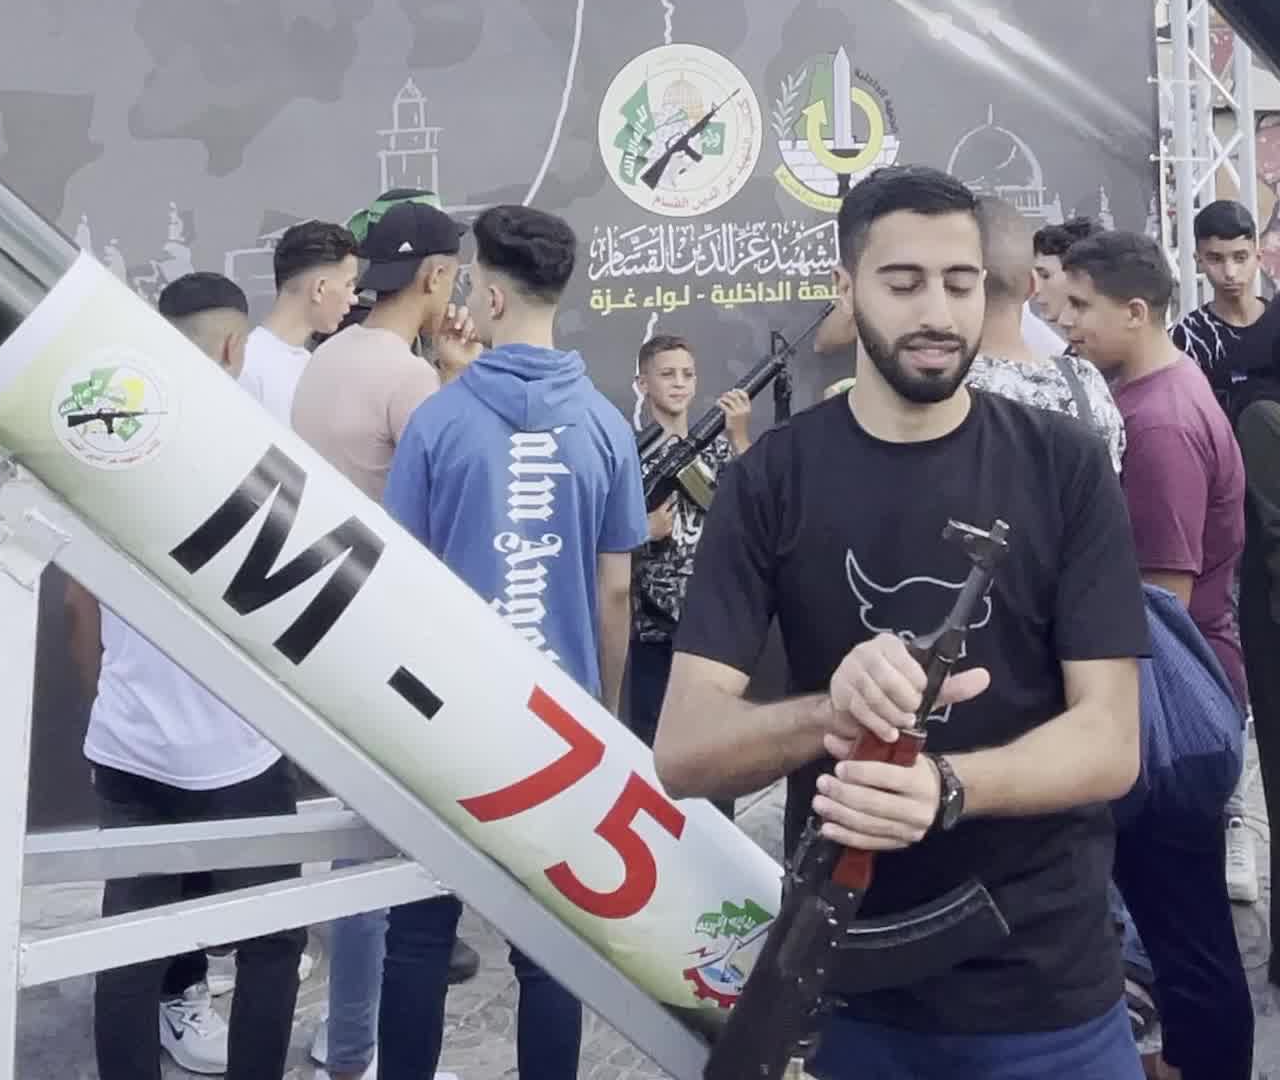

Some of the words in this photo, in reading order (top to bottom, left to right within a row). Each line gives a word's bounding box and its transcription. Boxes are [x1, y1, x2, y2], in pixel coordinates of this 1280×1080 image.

[589, 287, 637, 316] غزة
[642, 285, 690, 312] لواء
[711, 281, 791, 309] الداخلية
[506, 425, 571, 521] alm
